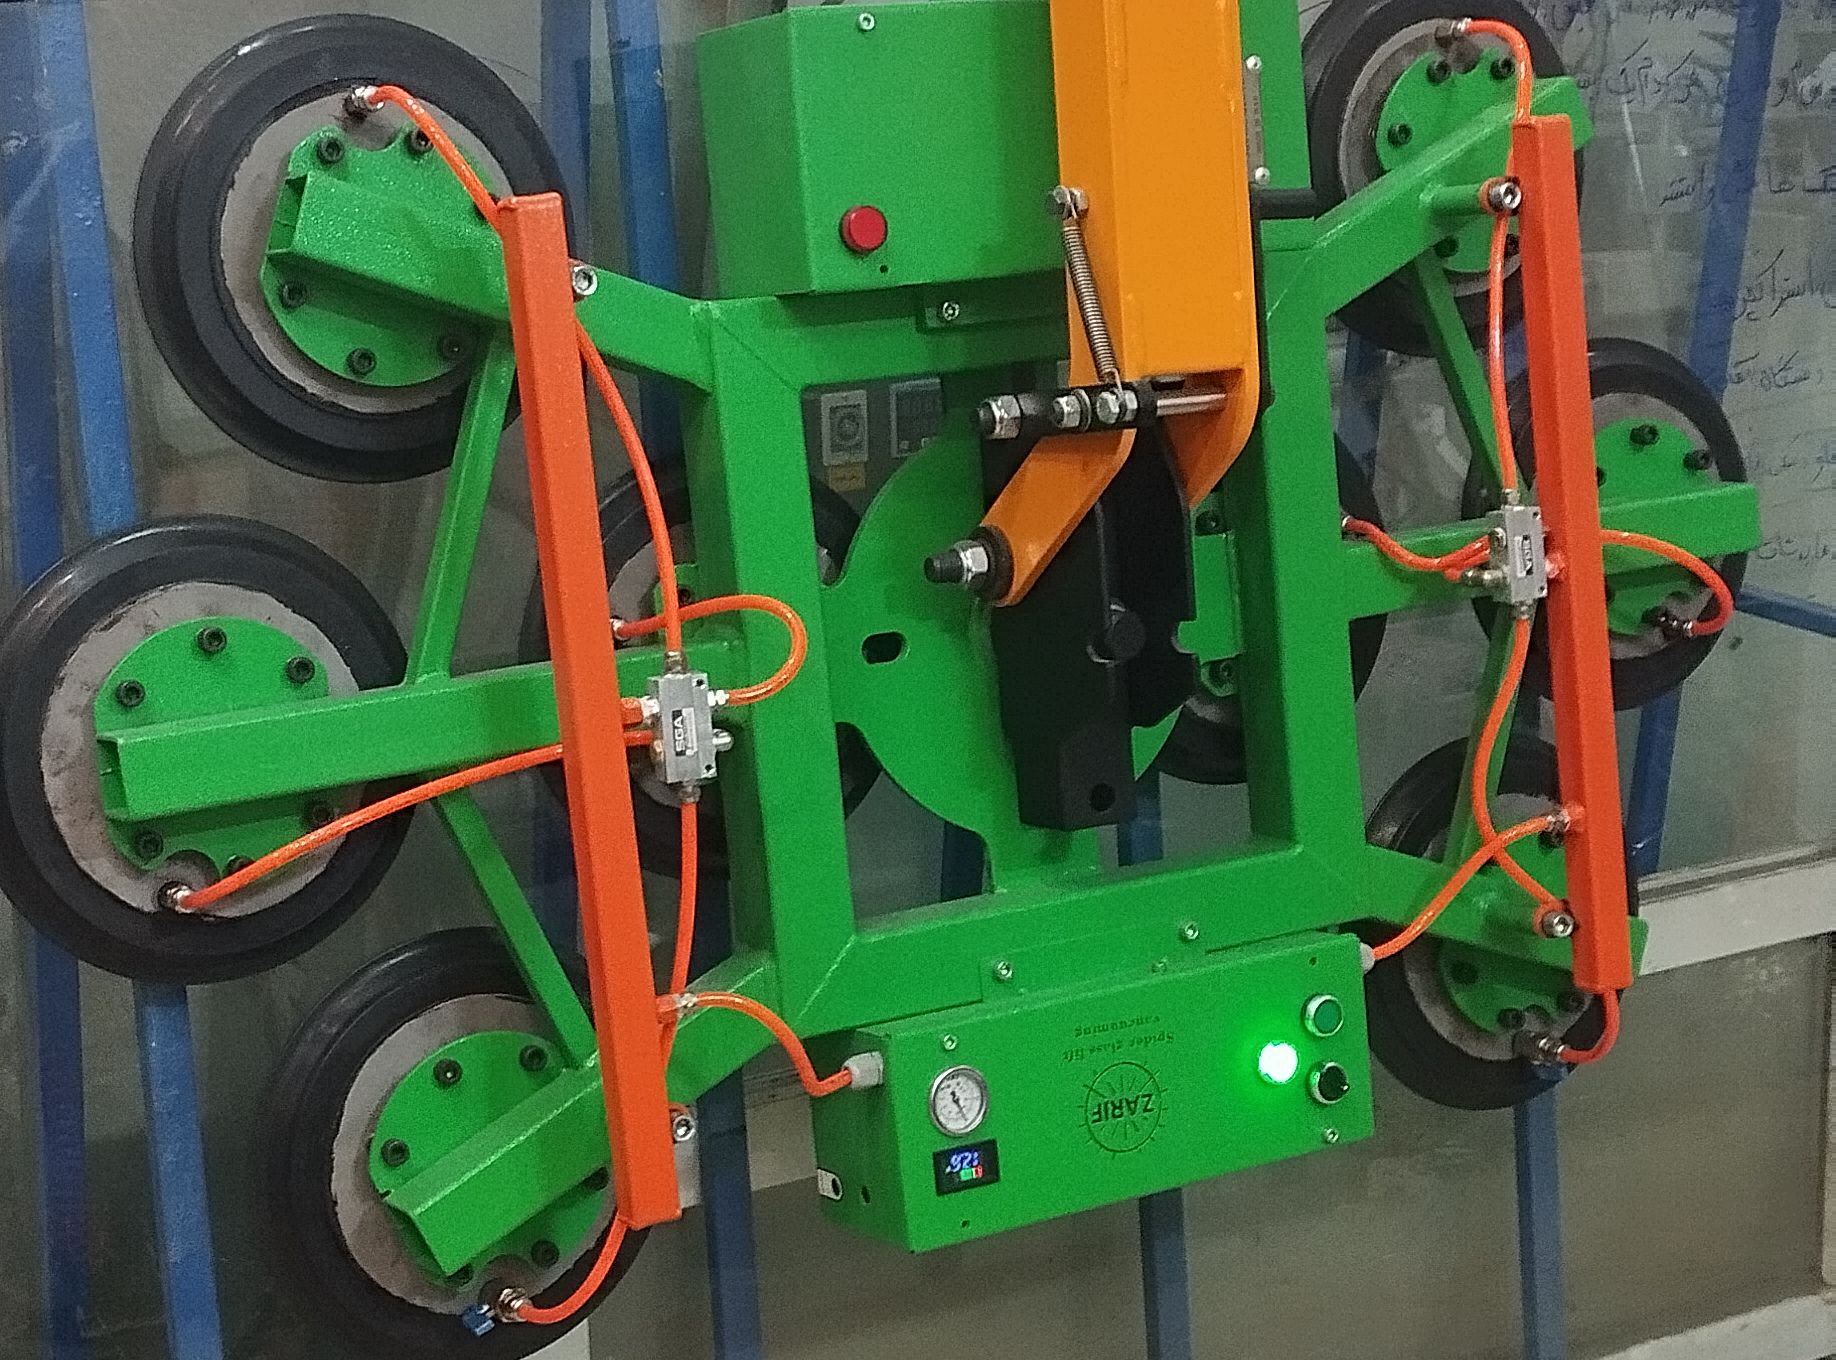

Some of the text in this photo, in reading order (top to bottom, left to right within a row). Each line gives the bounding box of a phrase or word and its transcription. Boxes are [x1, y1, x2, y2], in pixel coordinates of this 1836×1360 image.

[674, 715, 685, 752] SGA
[1128, 1031, 1175, 1049] Spider
[1062, 1048, 1085, 1063] lift
[1090, 1093, 1155, 1125] ZARIF
